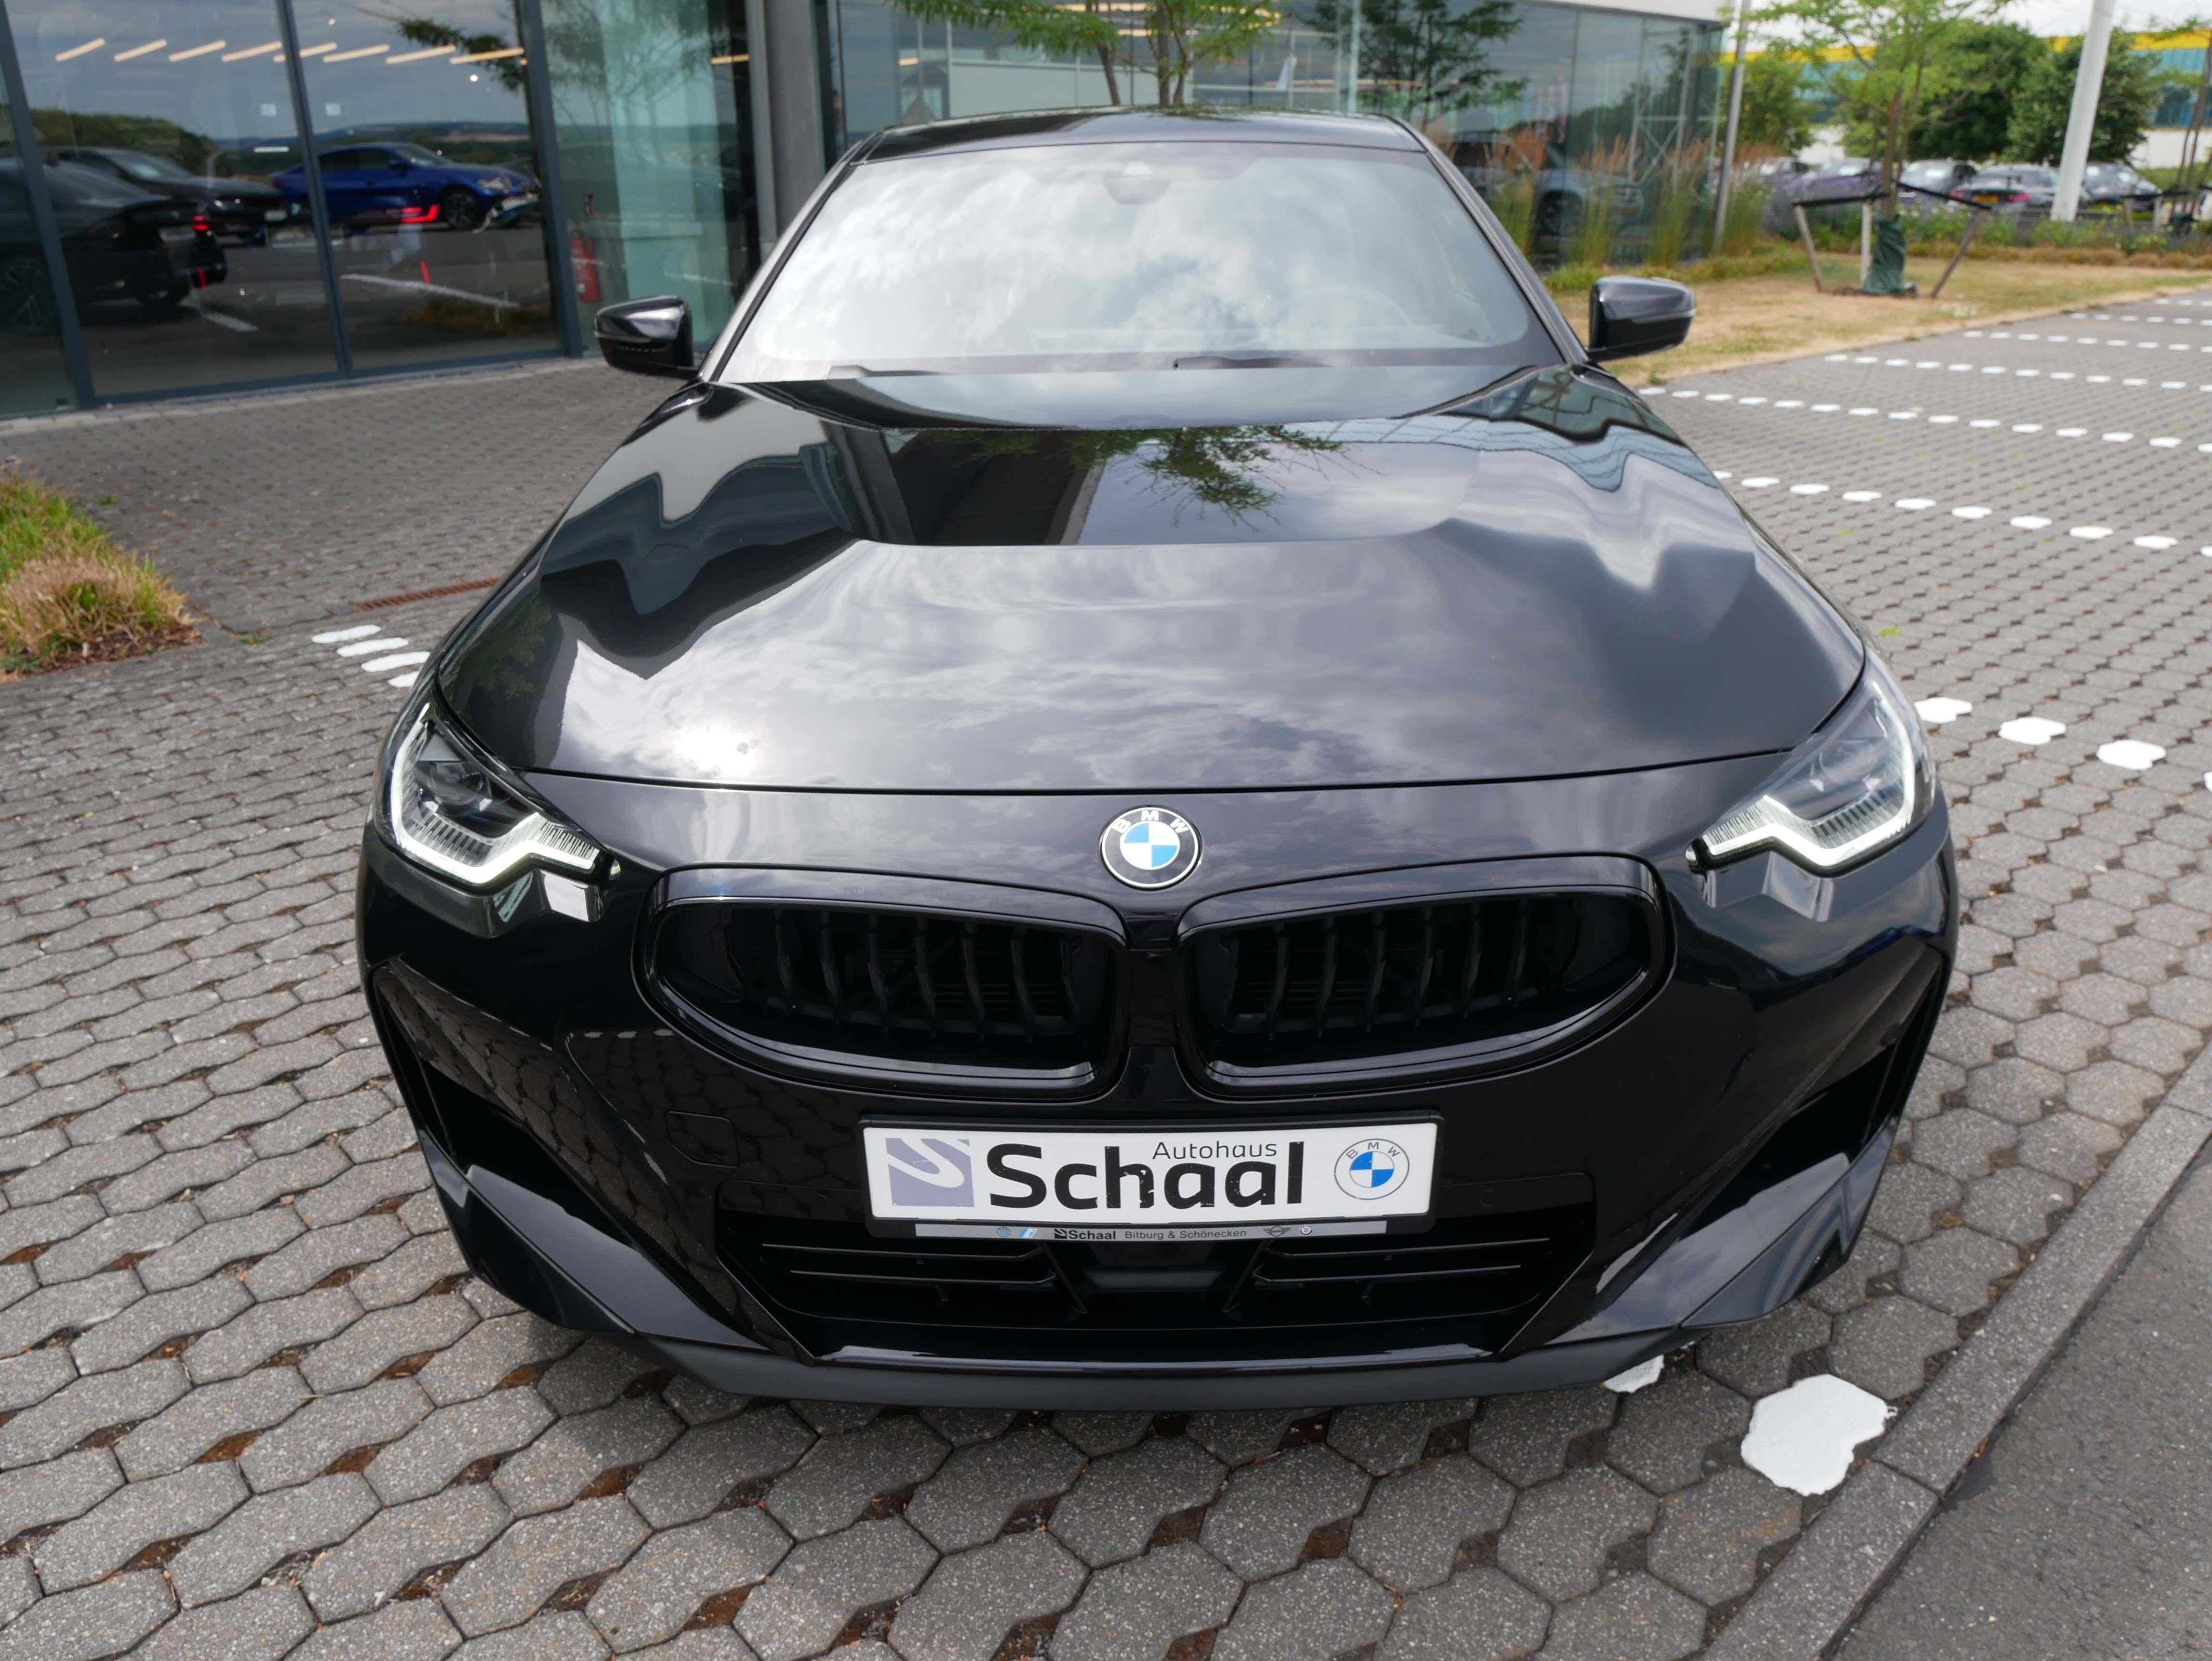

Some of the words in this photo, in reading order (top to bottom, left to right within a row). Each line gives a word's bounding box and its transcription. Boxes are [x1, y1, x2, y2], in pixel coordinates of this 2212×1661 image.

[1111, 810, 1189, 833] BMW
[1152, 1141, 1277, 1160] Autohaus
[1346, 1142, 1400, 1159] BMW
[987, 1141, 1304, 1210] Schaal
[1068, 1230, 1116, 1239] Schaal
[1125, 1230, 1164, 1240] Bitburg
[1180, 1229, 1247, 1239] Schönecken
